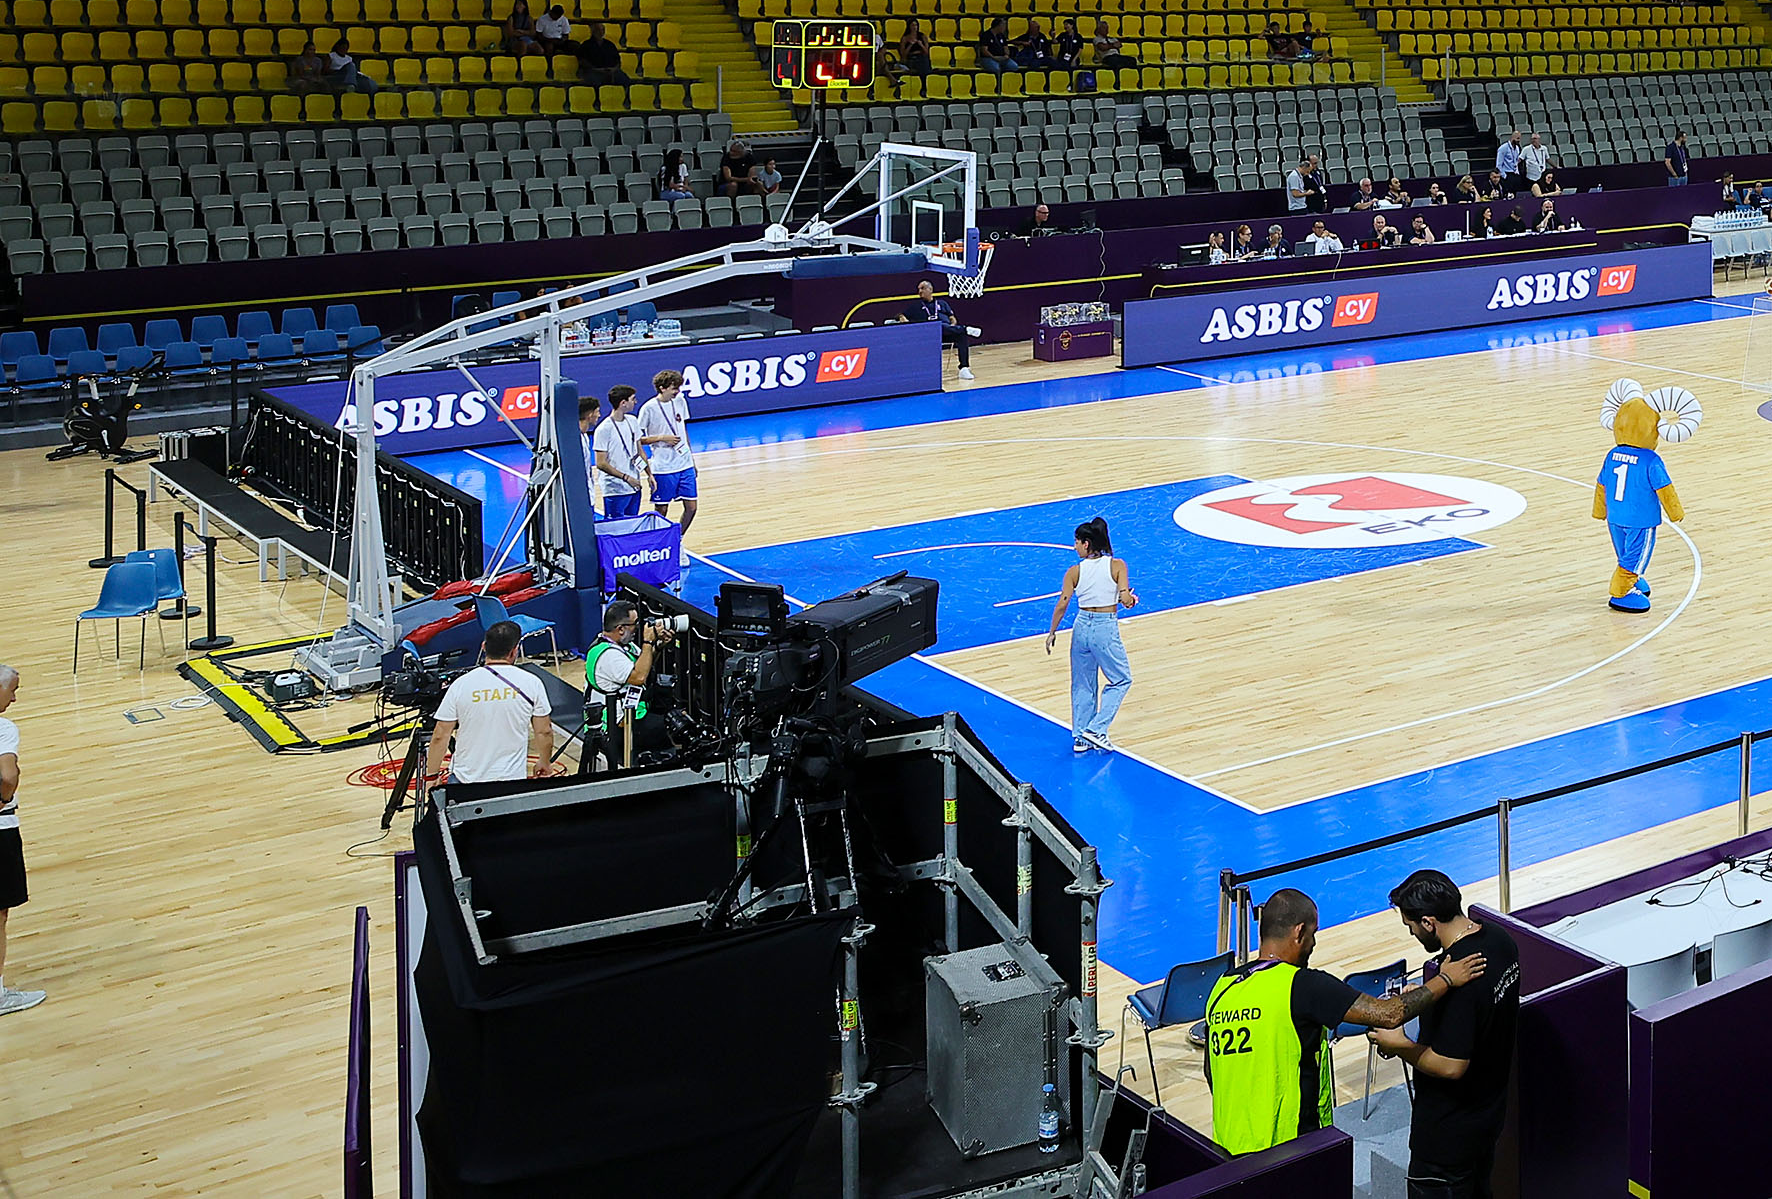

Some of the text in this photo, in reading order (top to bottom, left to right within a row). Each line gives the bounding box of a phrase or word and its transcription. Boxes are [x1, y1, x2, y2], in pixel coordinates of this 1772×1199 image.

[1486, 268, 1631, 310] ASBIS .cy
[1200, 298, 1372, 343] ASBIS .cy
[680, 353, 861, 398] ASBIS .cy
[1612, 463, 1628, 502] 1
[1361, 508, 1491, 534] EKO
[613, 547, 671, 569] molten
